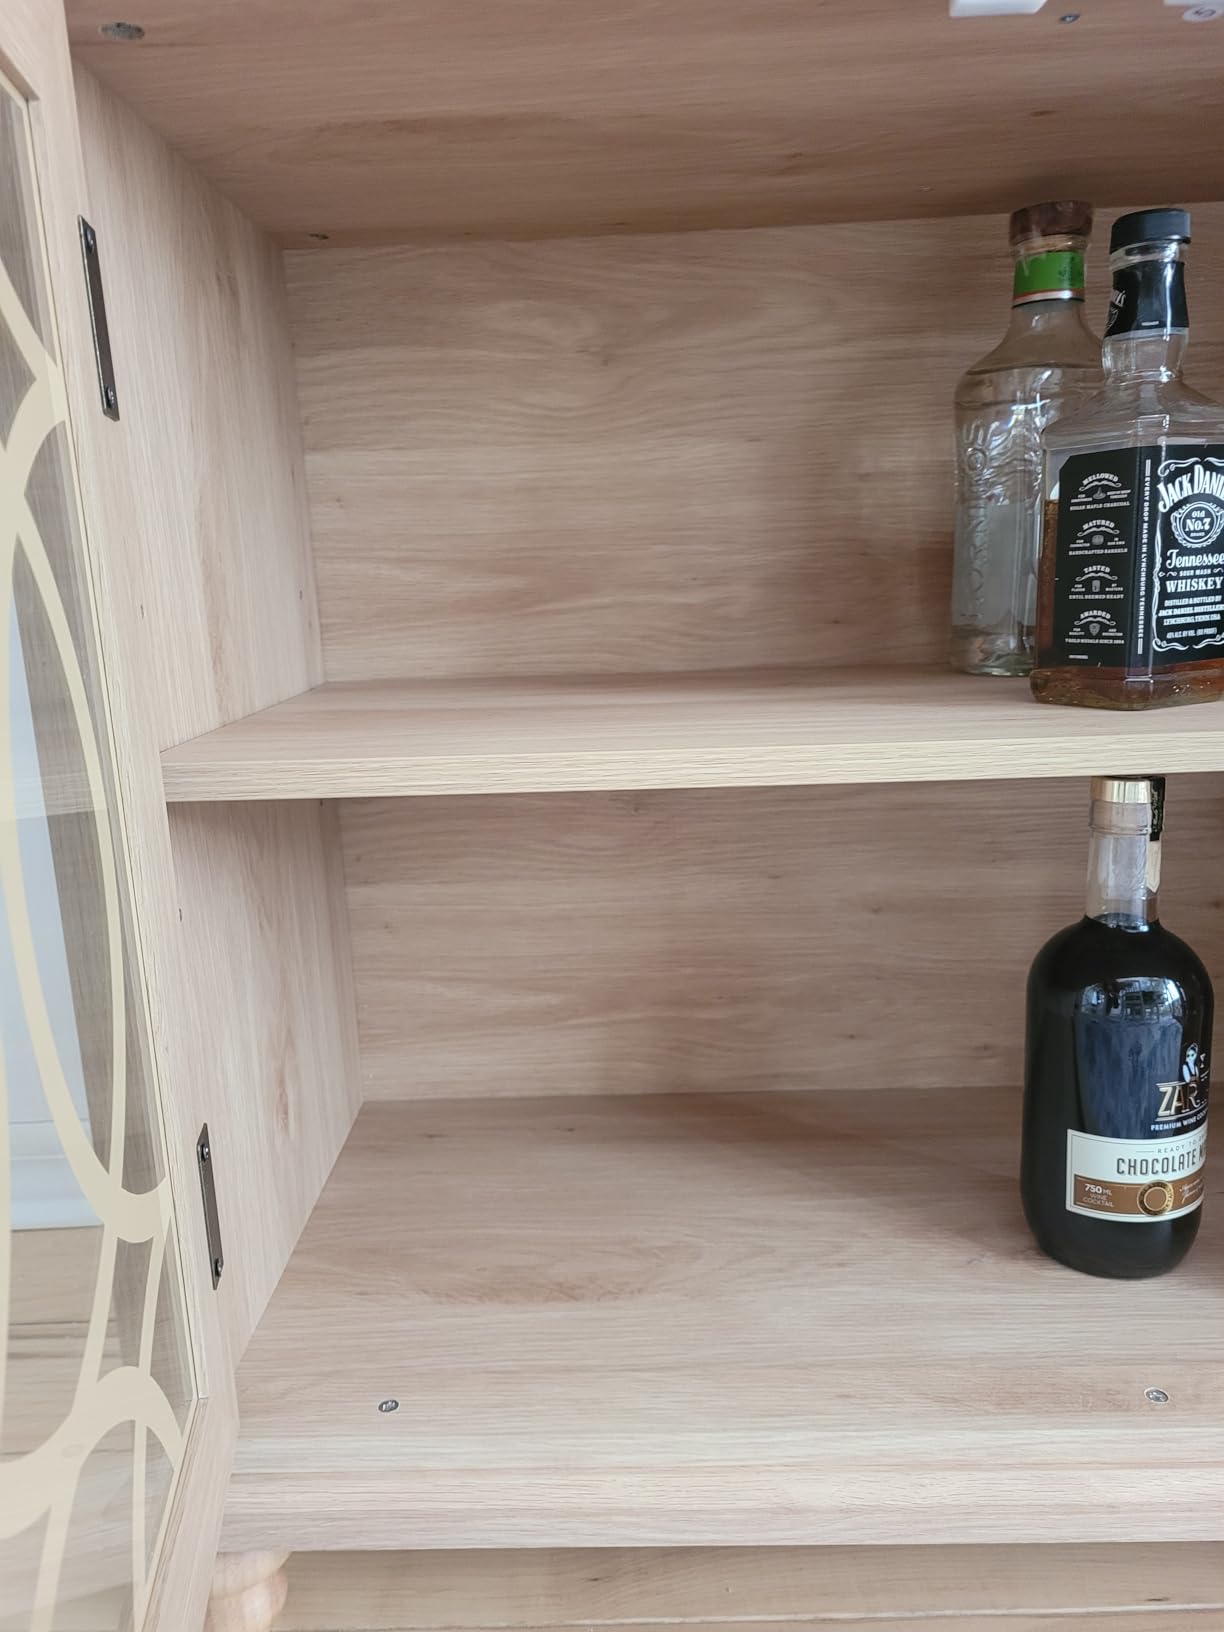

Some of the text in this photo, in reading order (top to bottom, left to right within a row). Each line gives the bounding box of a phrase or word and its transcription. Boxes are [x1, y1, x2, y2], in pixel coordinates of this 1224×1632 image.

[1082, 473, 1119, 486] MELLOWED
[1156, 472, 1193, 513] JACK
[1083, 520, 1115, 530] MATURED
[1185, 518, 1211, 531] No.7
[1142, 544, 1147, 553] IN
[1166, 549, 1224, 569] Tennessee
[1083, 565, 1110, 573] TASTED
[1166, 576, 1223, 593] WHISKEY
[1080, 610, 1111, 620] AWARDED
[1157, 1083, 1206, 1116] ZAR
[1150, 1121, 1181, 1131] PREMIUM
[1182, 1115, 1197, 1126] WINE
[1158, 1144, 1185, 1154] READY
[1116, 1148, 1197, 1176] CHOCOLATE
[1085, 1183, 1112, 1196] 750 ML
[1083, 1197, 1114, 1207] COCKTAIL
